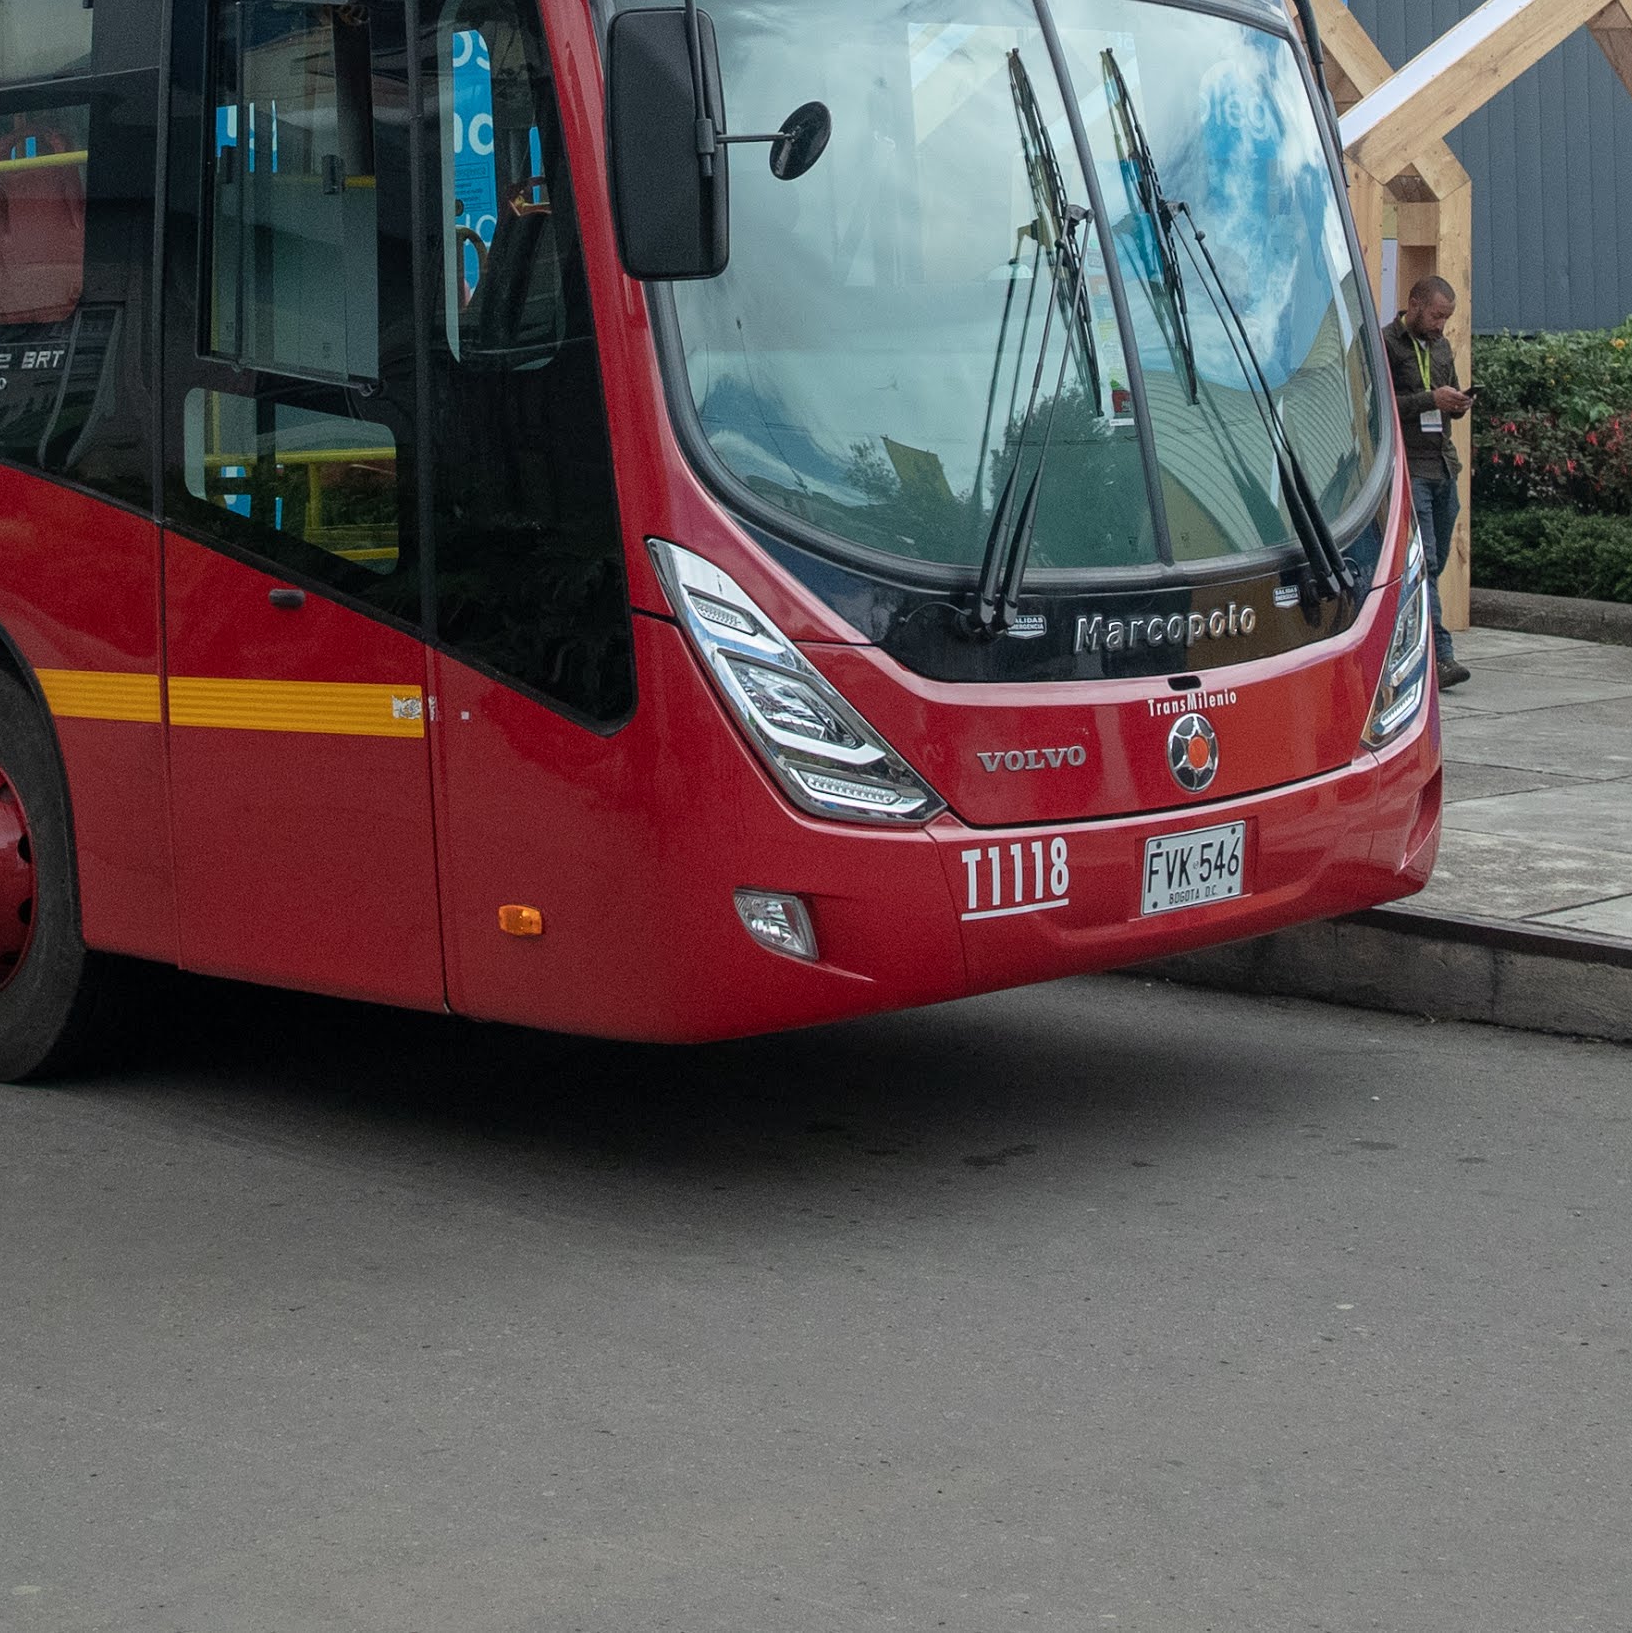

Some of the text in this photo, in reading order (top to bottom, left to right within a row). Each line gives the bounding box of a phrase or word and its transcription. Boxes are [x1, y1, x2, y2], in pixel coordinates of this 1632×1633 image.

[21, 349, 65, 370] BRT
[1074, 600, 1257, 654] Marcopolo
[1147, 689, 1238, 717] TransMilenio
[977, 745, 1087, 773] VOLVO
[961, 836, 1069, 910] T1118
